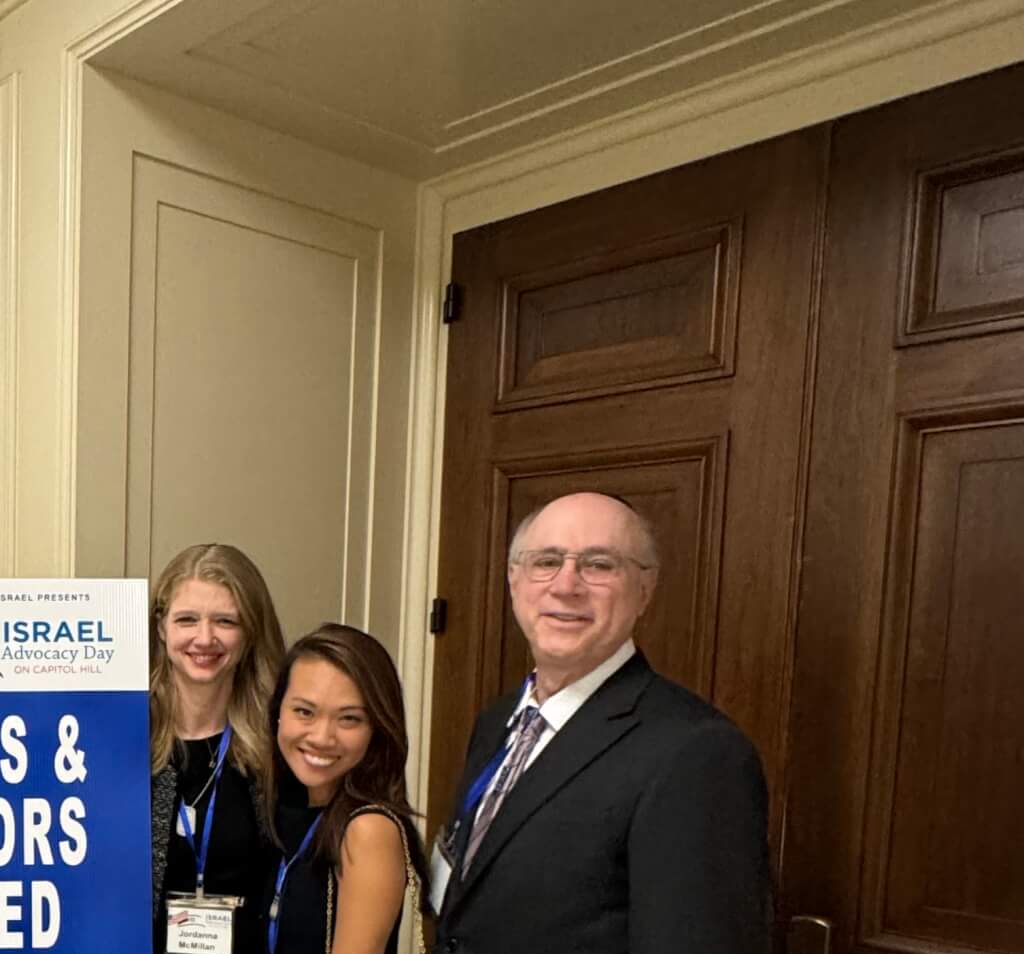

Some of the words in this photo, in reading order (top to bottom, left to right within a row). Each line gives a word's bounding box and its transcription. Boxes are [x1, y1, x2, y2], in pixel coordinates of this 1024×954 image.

[37, 594, 90, 602] PRESENTS
[4, 621, 113, 642] ISRAEL
[0, 645, 79, 664] Advocacy
[84, 645, 115, 664] Day
[14, 665, 30, 674] ON
[33, 665, 77, 674] CAPITOL
[80, 665, 103, 674] HILL
[54, 714, 88, 784] &
